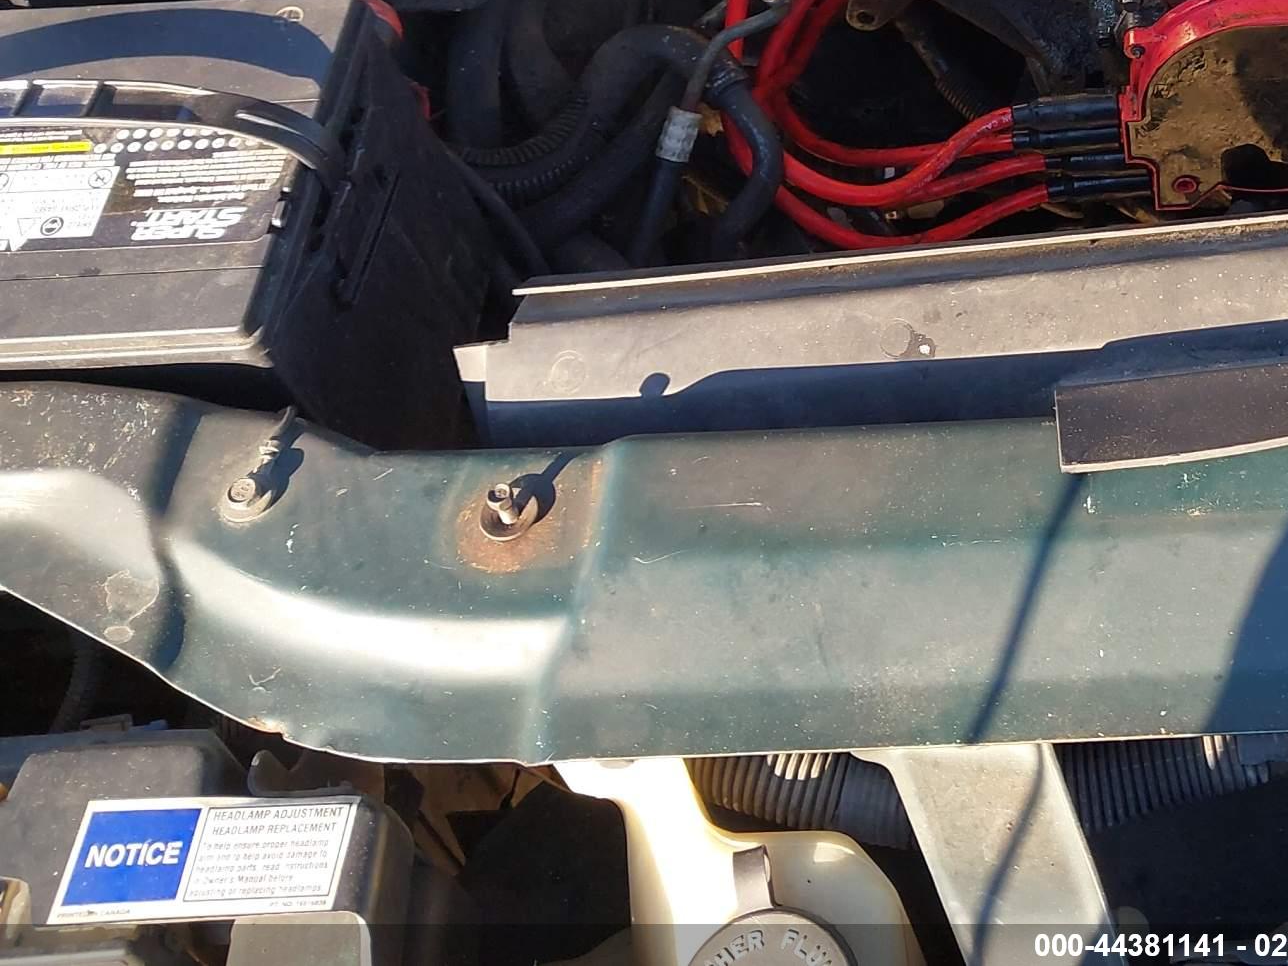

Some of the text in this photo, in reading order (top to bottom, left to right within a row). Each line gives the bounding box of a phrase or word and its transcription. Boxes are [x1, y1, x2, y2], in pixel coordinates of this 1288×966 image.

[136, 207, 247, 227] START
[131, 225, 226, 240] SUPER
[213, 807, 345, 822] HEADLAMP ADJUSTMENT
[212, 822, 337, 836] HEADLAMP REPLACEMENT
[213, 840, 231, 851] help
[233, 841, 260, 849] ensure
[261, 841, 288, 850] proper
[290, 839, 329, 849] headlamp
[84, 840, 183, 868] NOTICE
[261, 851, 283, 859] avoid
[286, 850, 317, 860] damage
[238, 874, 266, 884] Manual
[268, 874, 294, 883] before
[238, 885, 276, 896] replacing
